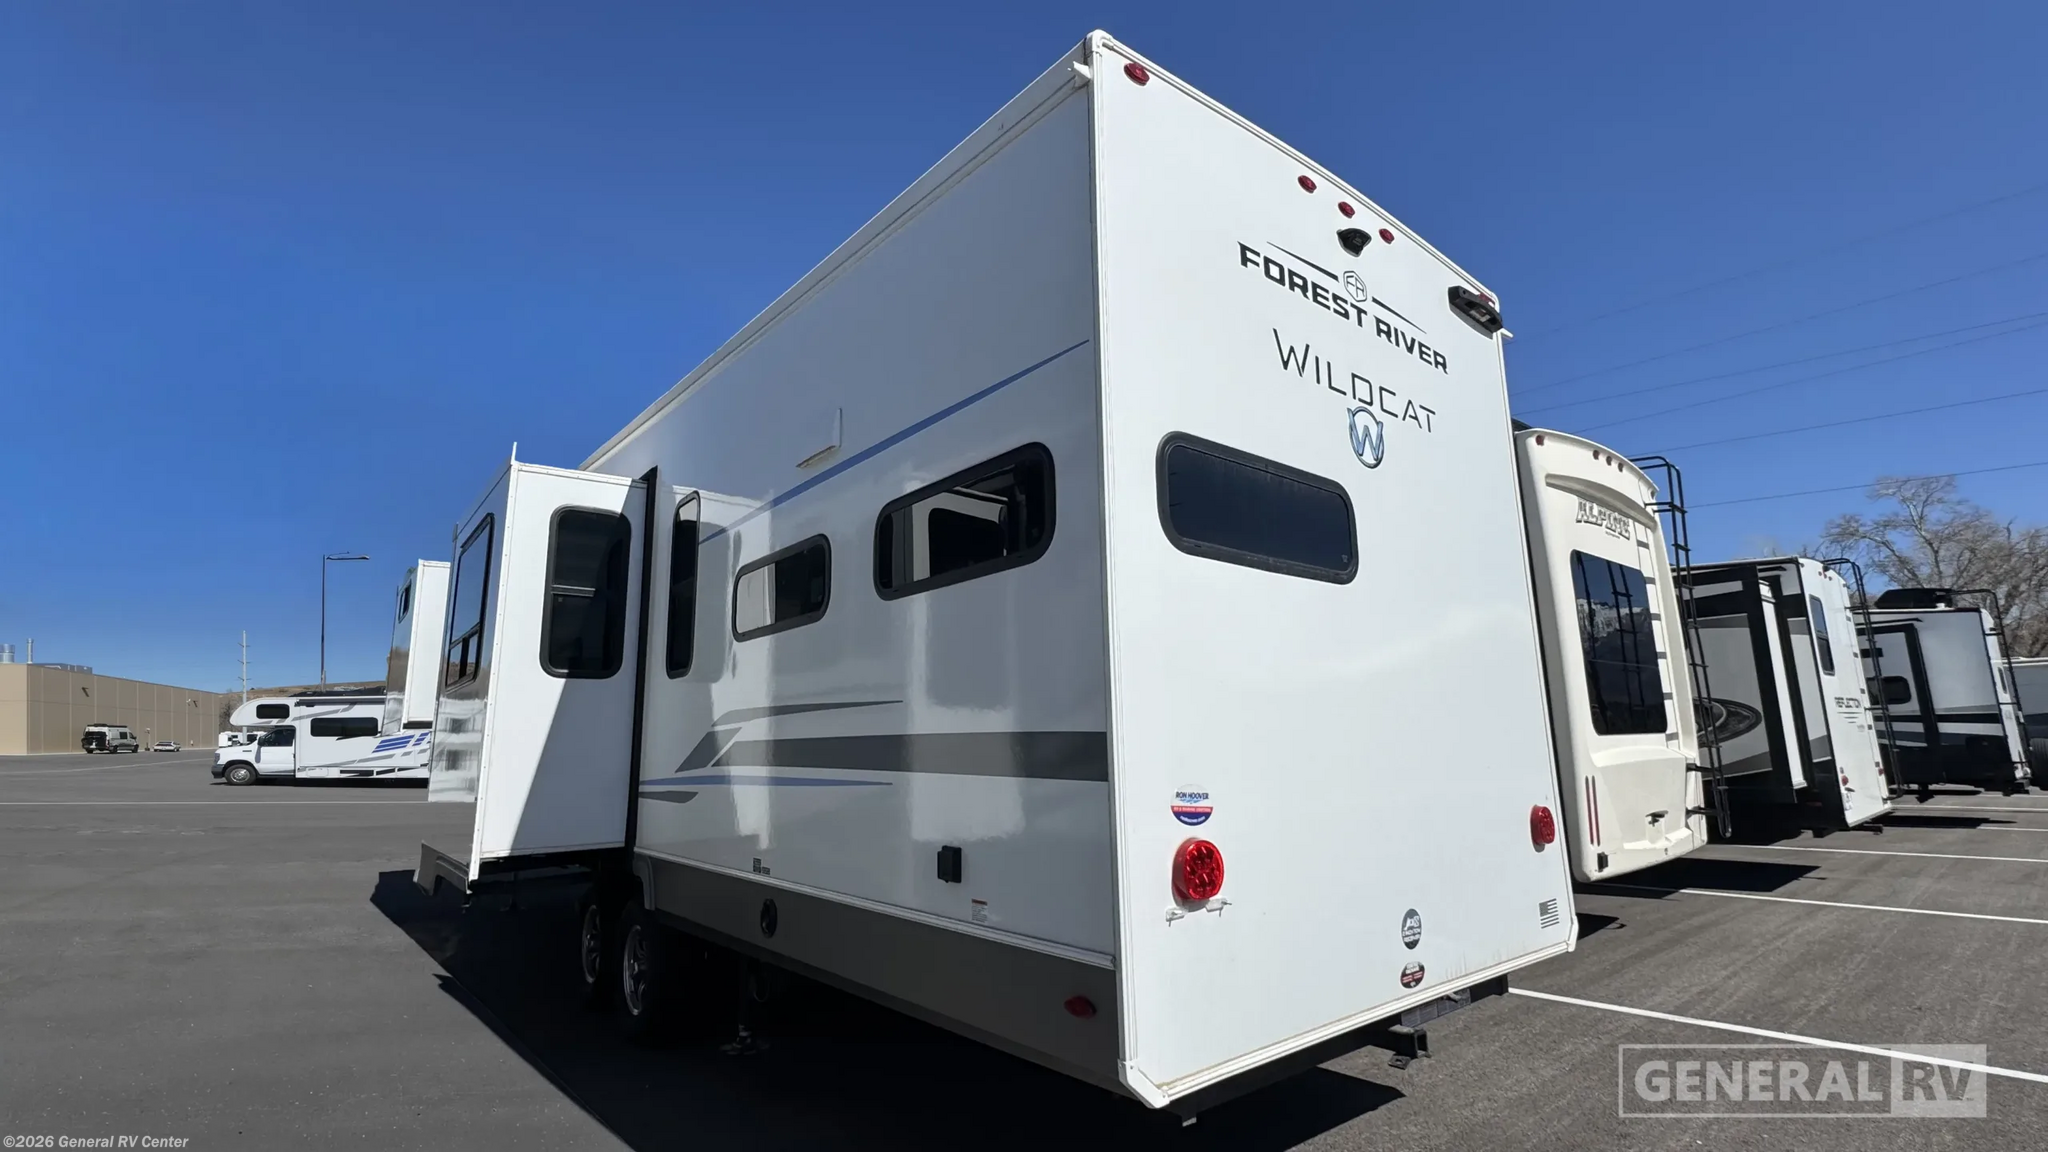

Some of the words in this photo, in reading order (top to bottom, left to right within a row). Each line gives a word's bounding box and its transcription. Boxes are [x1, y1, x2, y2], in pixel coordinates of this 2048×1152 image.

[1237, 241, 1367, 328] FOREST
[1373, 315, 1449, 375] RIVER
[1273, 327, 1436, 433] WILDCAT
